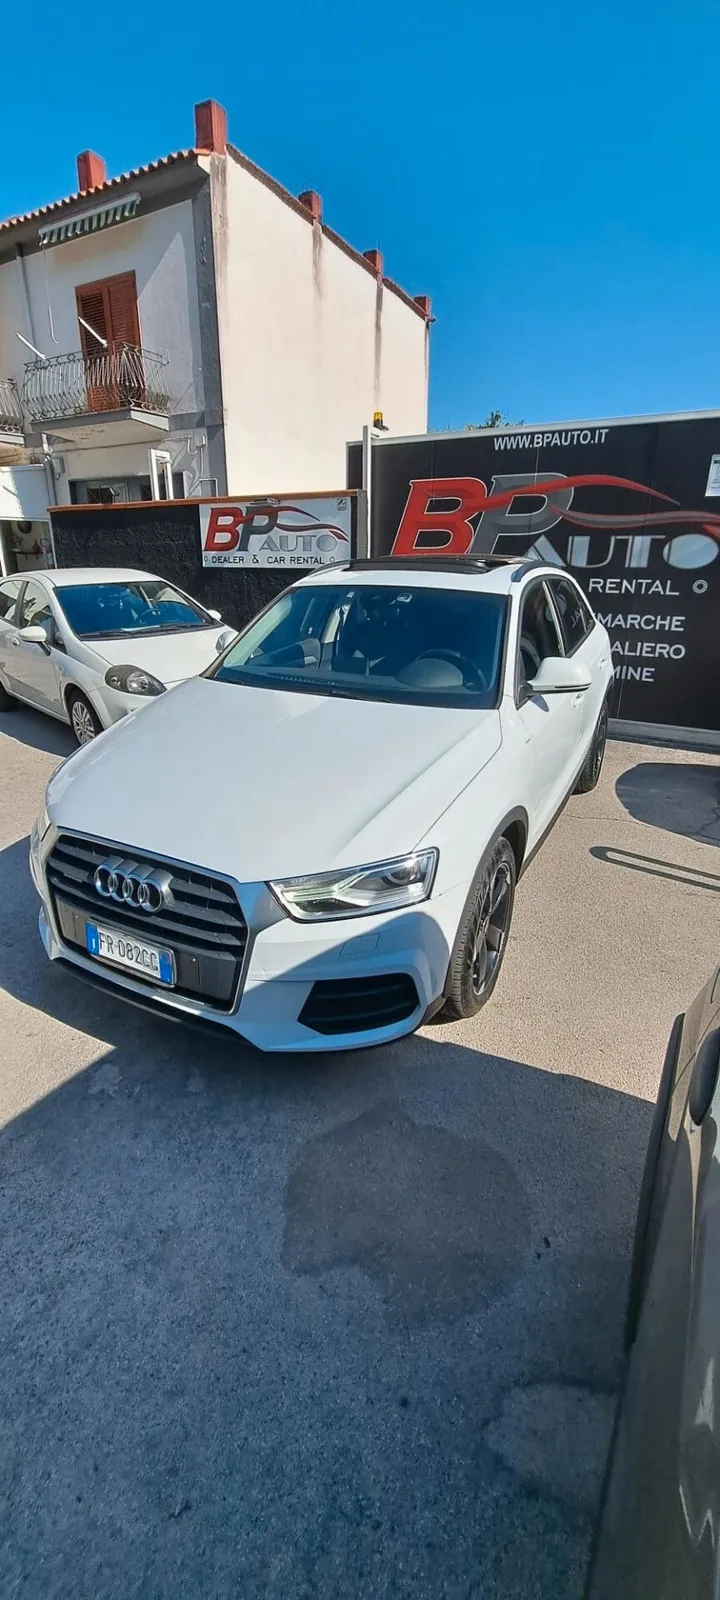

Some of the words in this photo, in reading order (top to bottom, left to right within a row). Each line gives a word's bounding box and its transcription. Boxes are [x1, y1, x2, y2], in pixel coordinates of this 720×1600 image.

[493, 429, 609, 451] WWW.BPAUTO.IT
[390, 472, 574, 556] BP
[204, 505, 279, 552] BP
[258, 534, 338, 552] AUTO
[211, 555, 245, 564] DEALER
[252, 554, 259, 565] &
[266, 556, 286, 565] CAR
[289, 556, 325, 565] RENTAL
[588, 578, 680, 596] RENTAL
[594, 612, 686, 632] MARCHE
[610, 641, 686, 660] ALIERO
